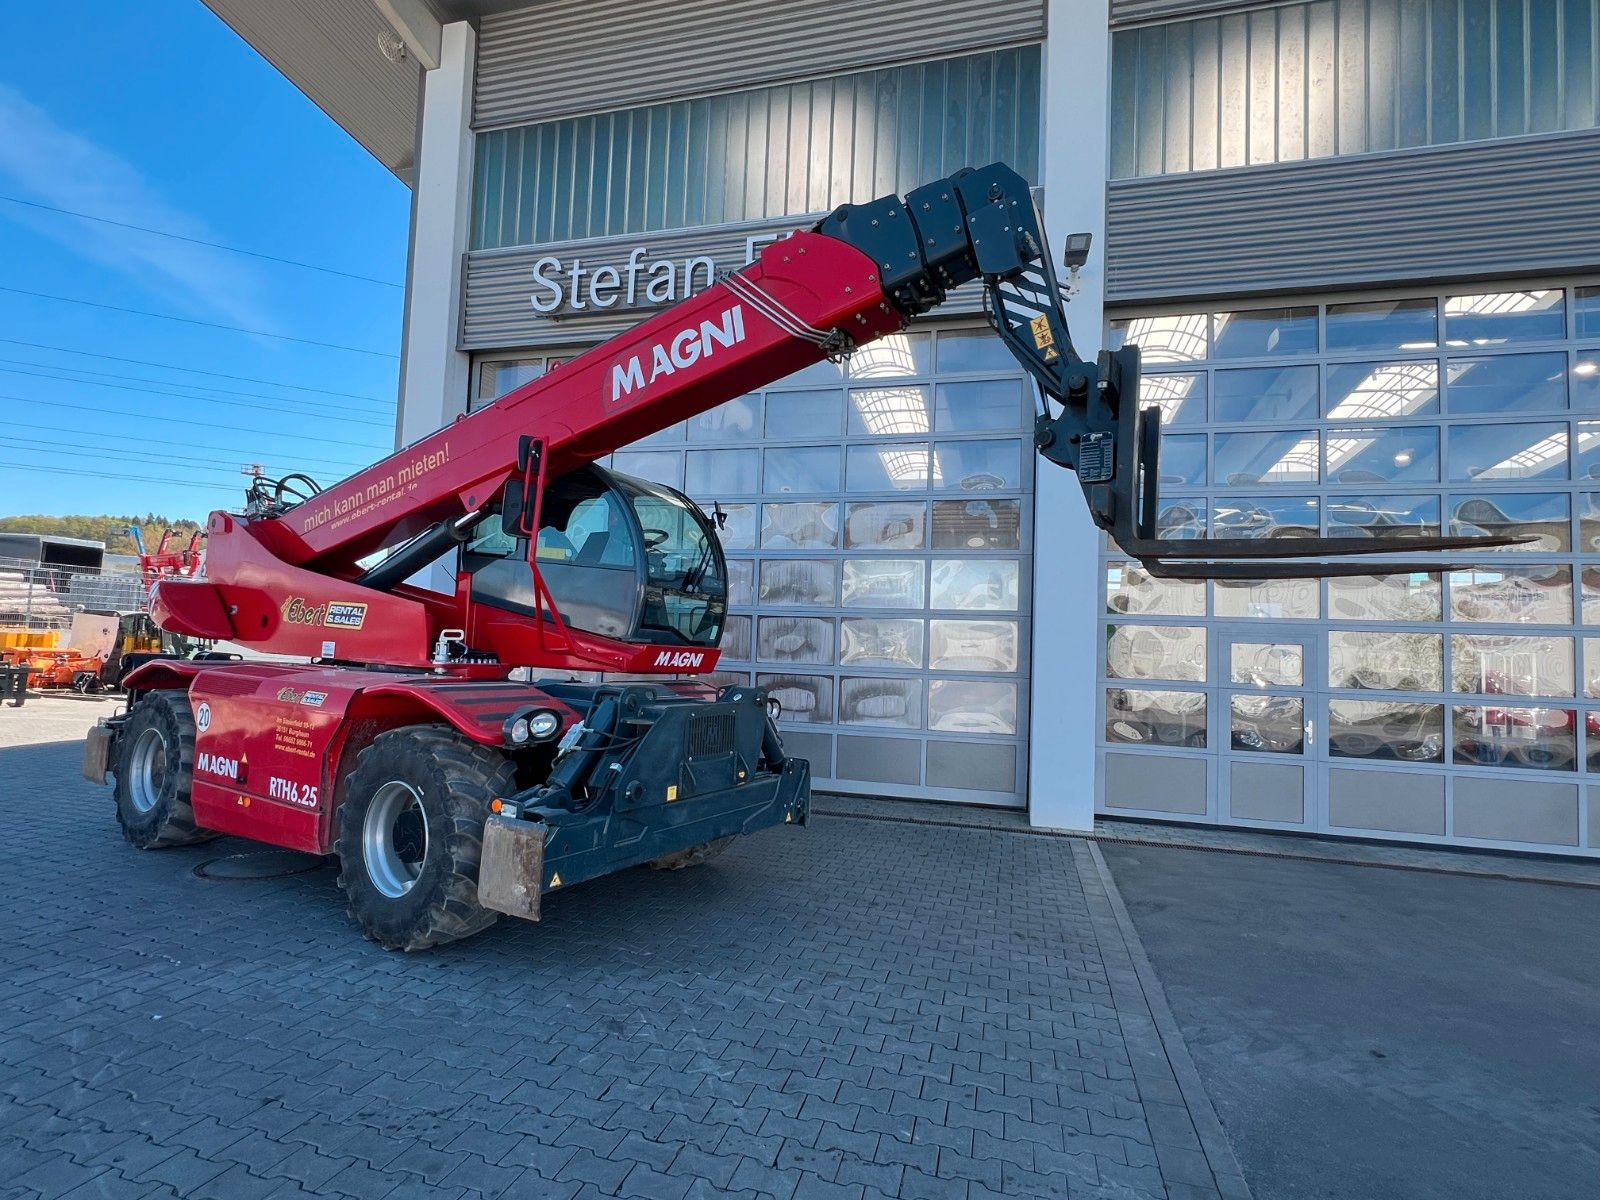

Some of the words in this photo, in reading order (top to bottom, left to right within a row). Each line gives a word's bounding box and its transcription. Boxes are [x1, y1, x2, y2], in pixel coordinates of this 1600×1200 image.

[530, 247, 715, 312] Stefan
[611, 304, 746, 402] MAGNI
[304, 506, 331, 532] mich
[334, 492, 364, 517] kann
[366, 475, 395, 500] man
[399, 442, 450, 485] mieten!
[287, 598, 325, 627] Ebert
[329, 606, 362, 616] RENTAL
[334, 616, 361, 625] SALES
[653, 651, 705, 668] MAGNI
[199, 707, 210, 727] 20
[197, 752, 239, 779] MAGNI
[269, 776, 318, 808] RTH6.25
